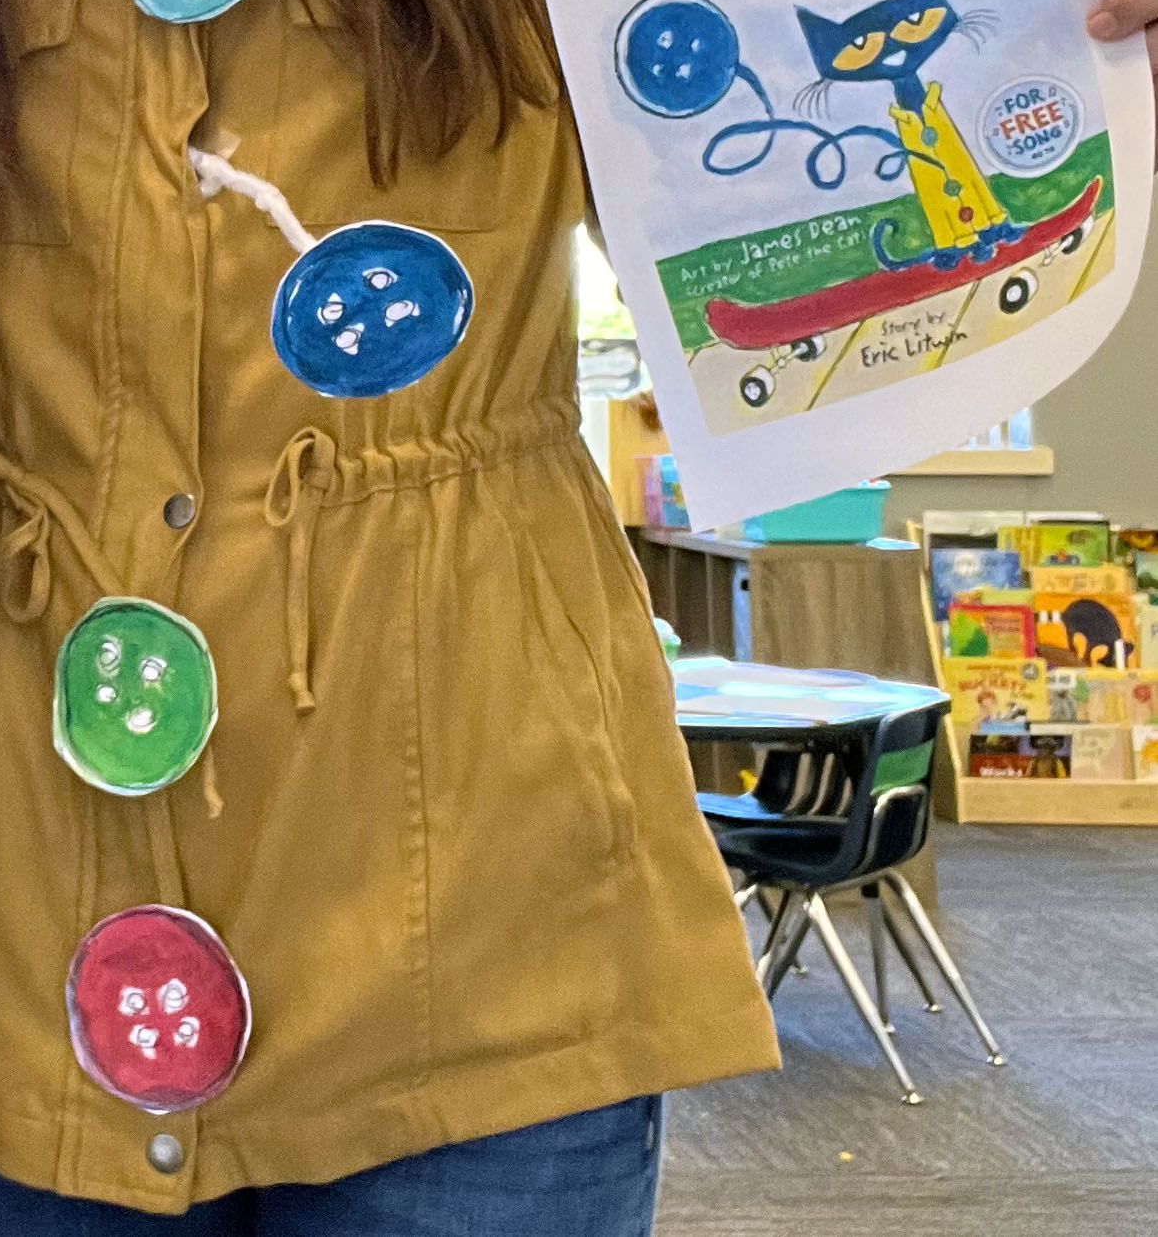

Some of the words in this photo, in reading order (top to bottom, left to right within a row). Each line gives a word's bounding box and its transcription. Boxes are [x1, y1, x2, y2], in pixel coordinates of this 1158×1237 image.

[1004, 87, 1046, 114] FOR
[999, 100, 1064, 140] FREE
[1012, 124, 1062, 155] SONG
[681, 266, 706, 283] Art
[712, 258, 733, 273] by
[741, 228, 802, 265] James
[809, 215, 861, 239] Dean
[882, 318, 921, 336] Story
[926, 311, 946, 324] by
[861, 341, 899, 368] Eric
